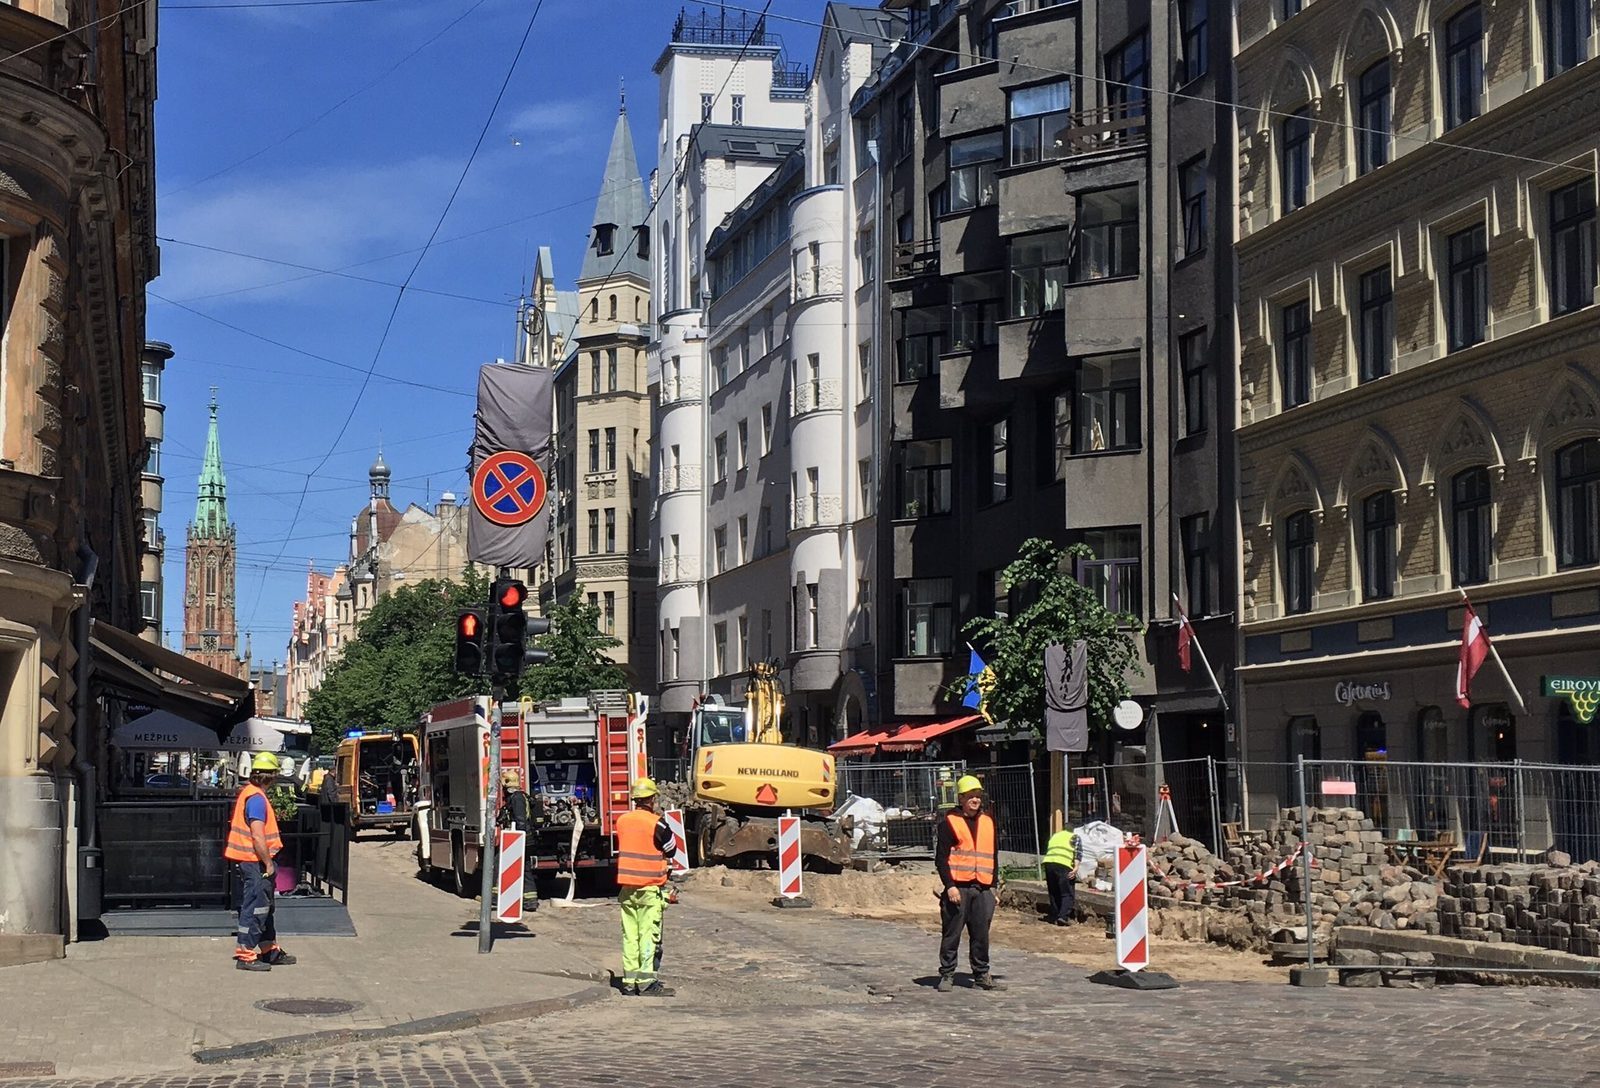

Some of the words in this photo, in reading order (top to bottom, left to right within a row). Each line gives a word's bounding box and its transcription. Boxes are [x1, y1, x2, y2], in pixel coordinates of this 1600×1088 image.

[134, 732, 178, 742] MEŽPILS
[737, 767, 758, 776] NEW
[759, 768, 799, 778] HOLLAND
